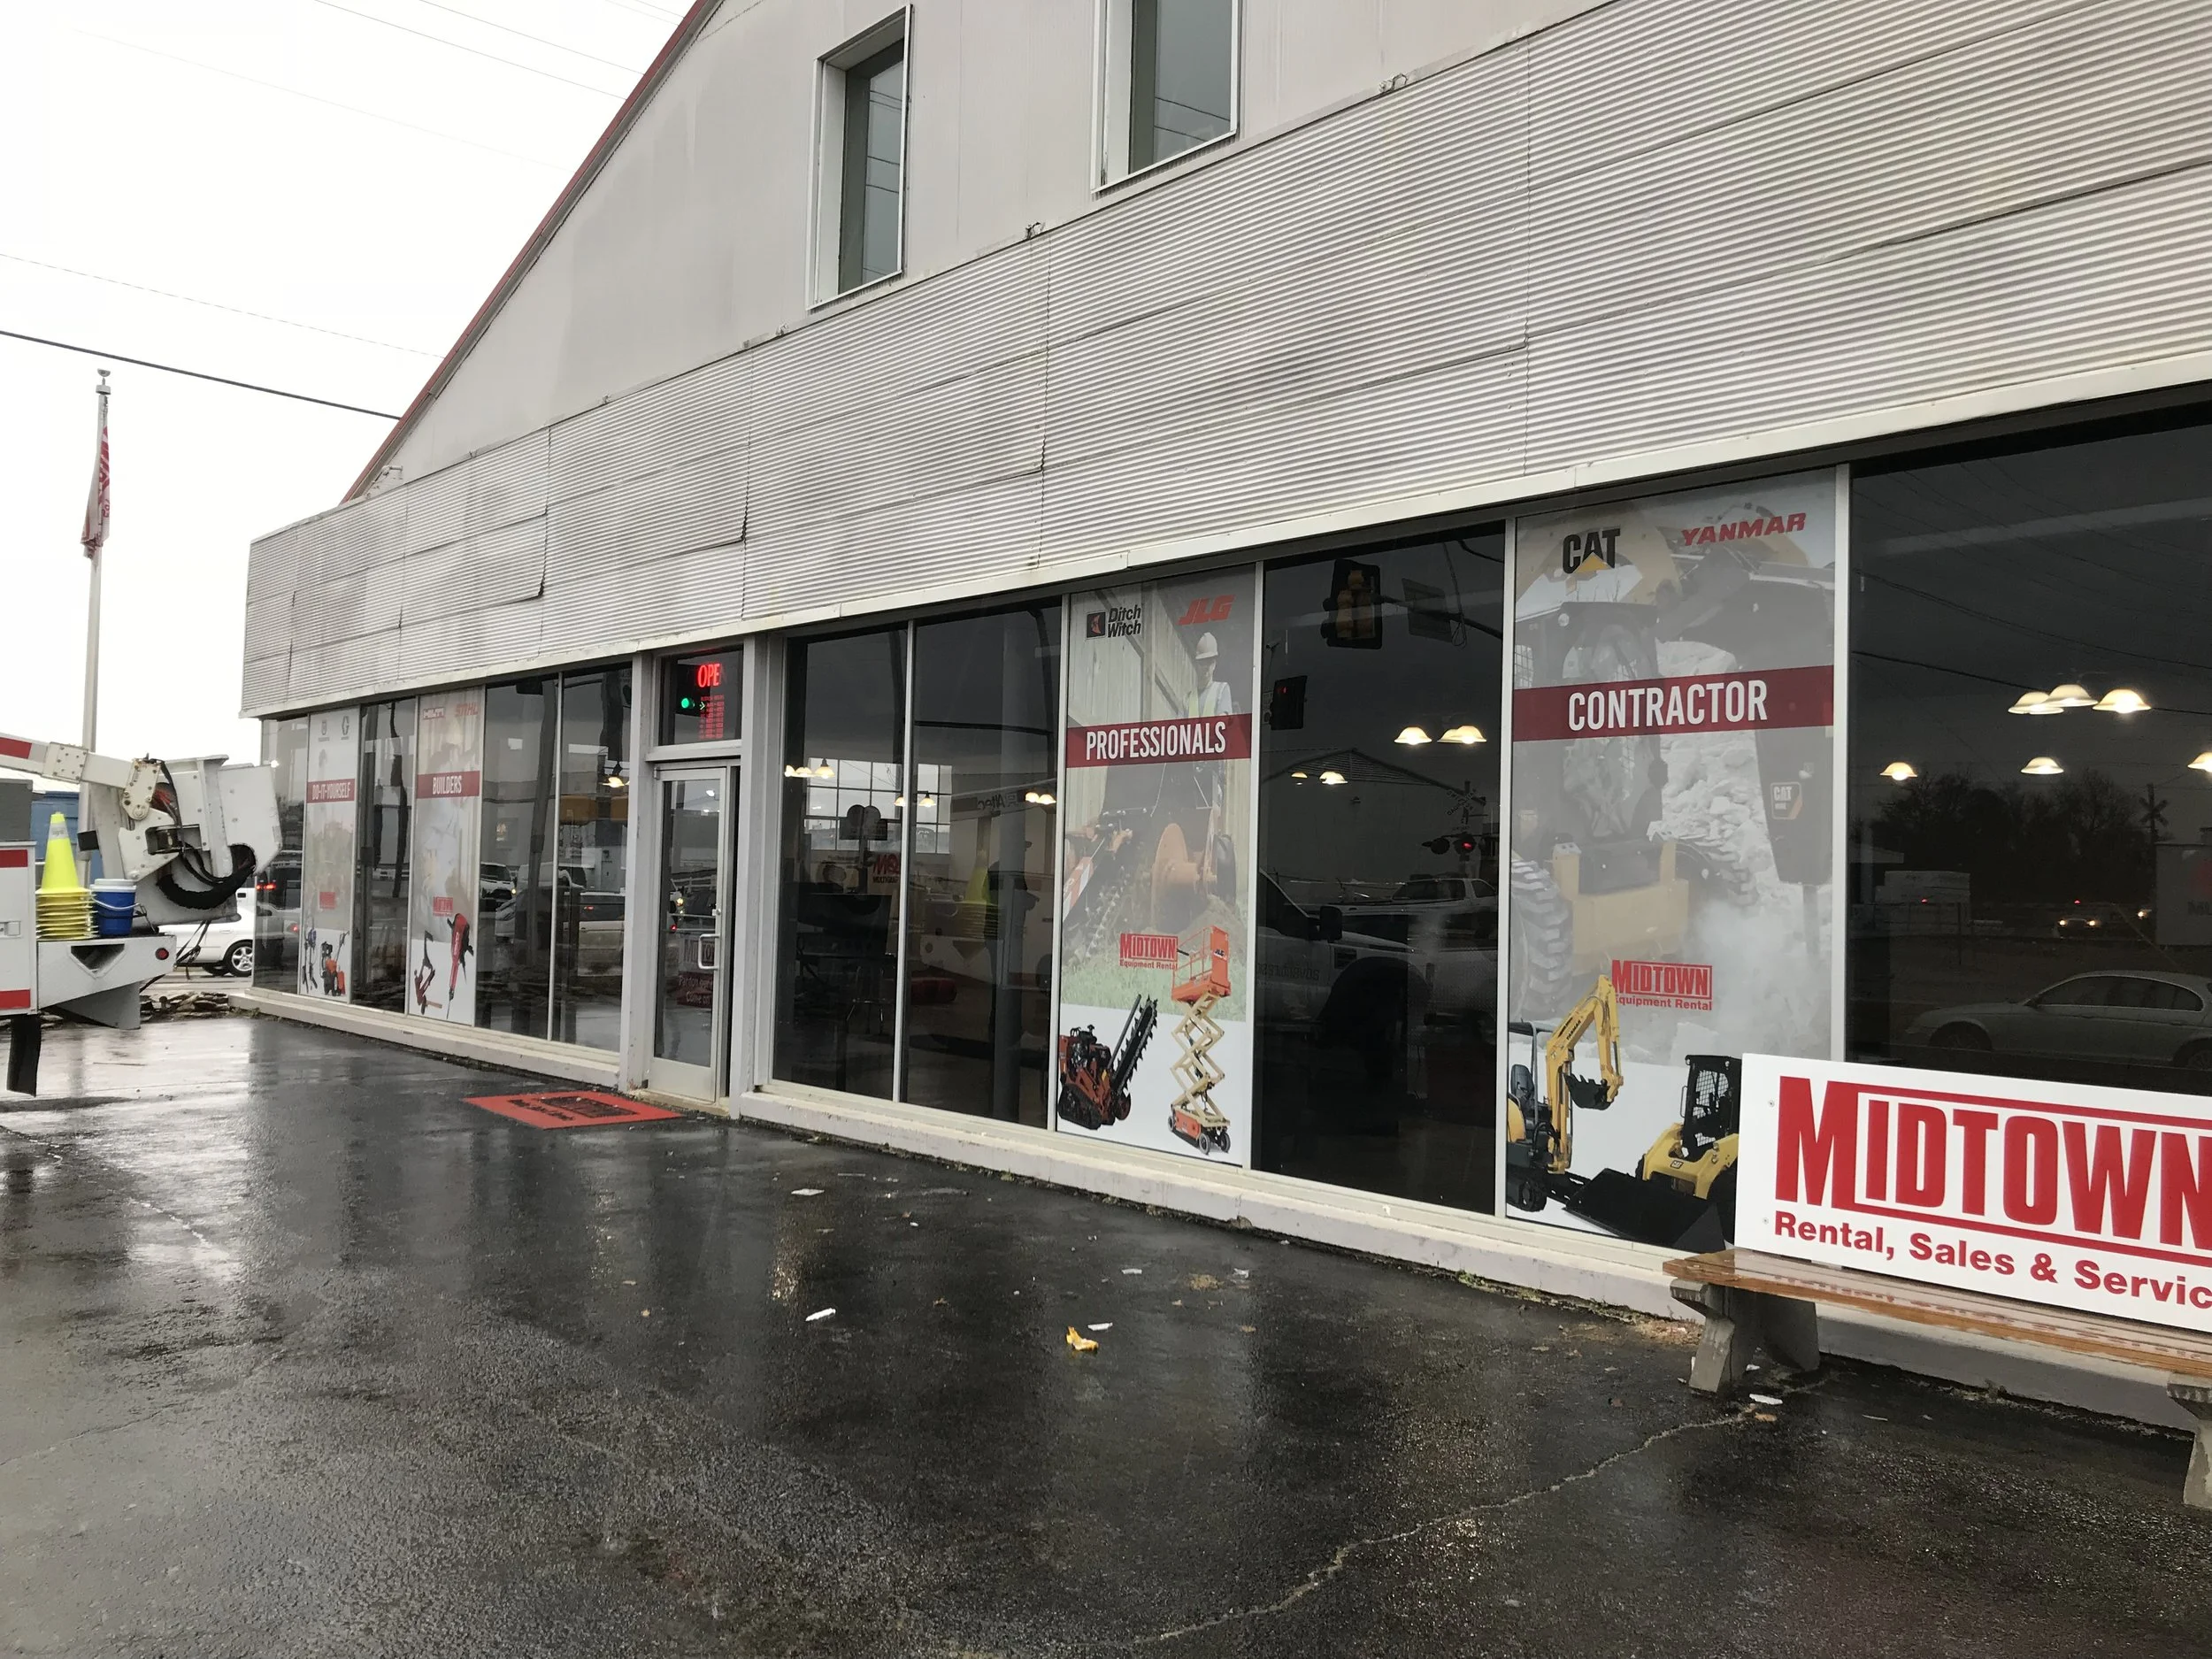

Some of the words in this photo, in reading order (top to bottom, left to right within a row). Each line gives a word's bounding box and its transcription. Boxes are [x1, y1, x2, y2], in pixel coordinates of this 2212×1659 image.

[1681, 512, 1807, 547] YANMAR
[1563, 528, 1621, 574] CAT
[1108, 604, 1141, 624] Ditch
[1176, 595, 1236, 626] JLG
[1107, 620, 1141, 639] Witch
[1568, 680, 1768, 732] CONTRACTOR
[1086, 721, 1226, 761] PROFESSIONALS
[311, 782, 351, 801] DO-IT-YOURSELF
[433, 775, 462, 795] BUILDERS
[1119, 933, 1177, 959] MIDTOWN
[1119, 958, 1155, 971] Equipment
[1156, 961, 1178, 971] Rental
[1612, 960, 1710, 996] MIDTOWN
[1675, 998, 1712, 1011] Rental
[1775, 1075, 2212, 1251] MIDTOWN
[1774, 1210, 1895, 1262] Rental,
[1909, 1232, 2016, 1277] Sales
[2029, 1252, 2059, 1284] &
[2073, 1259, 2212, 1310] Servic
